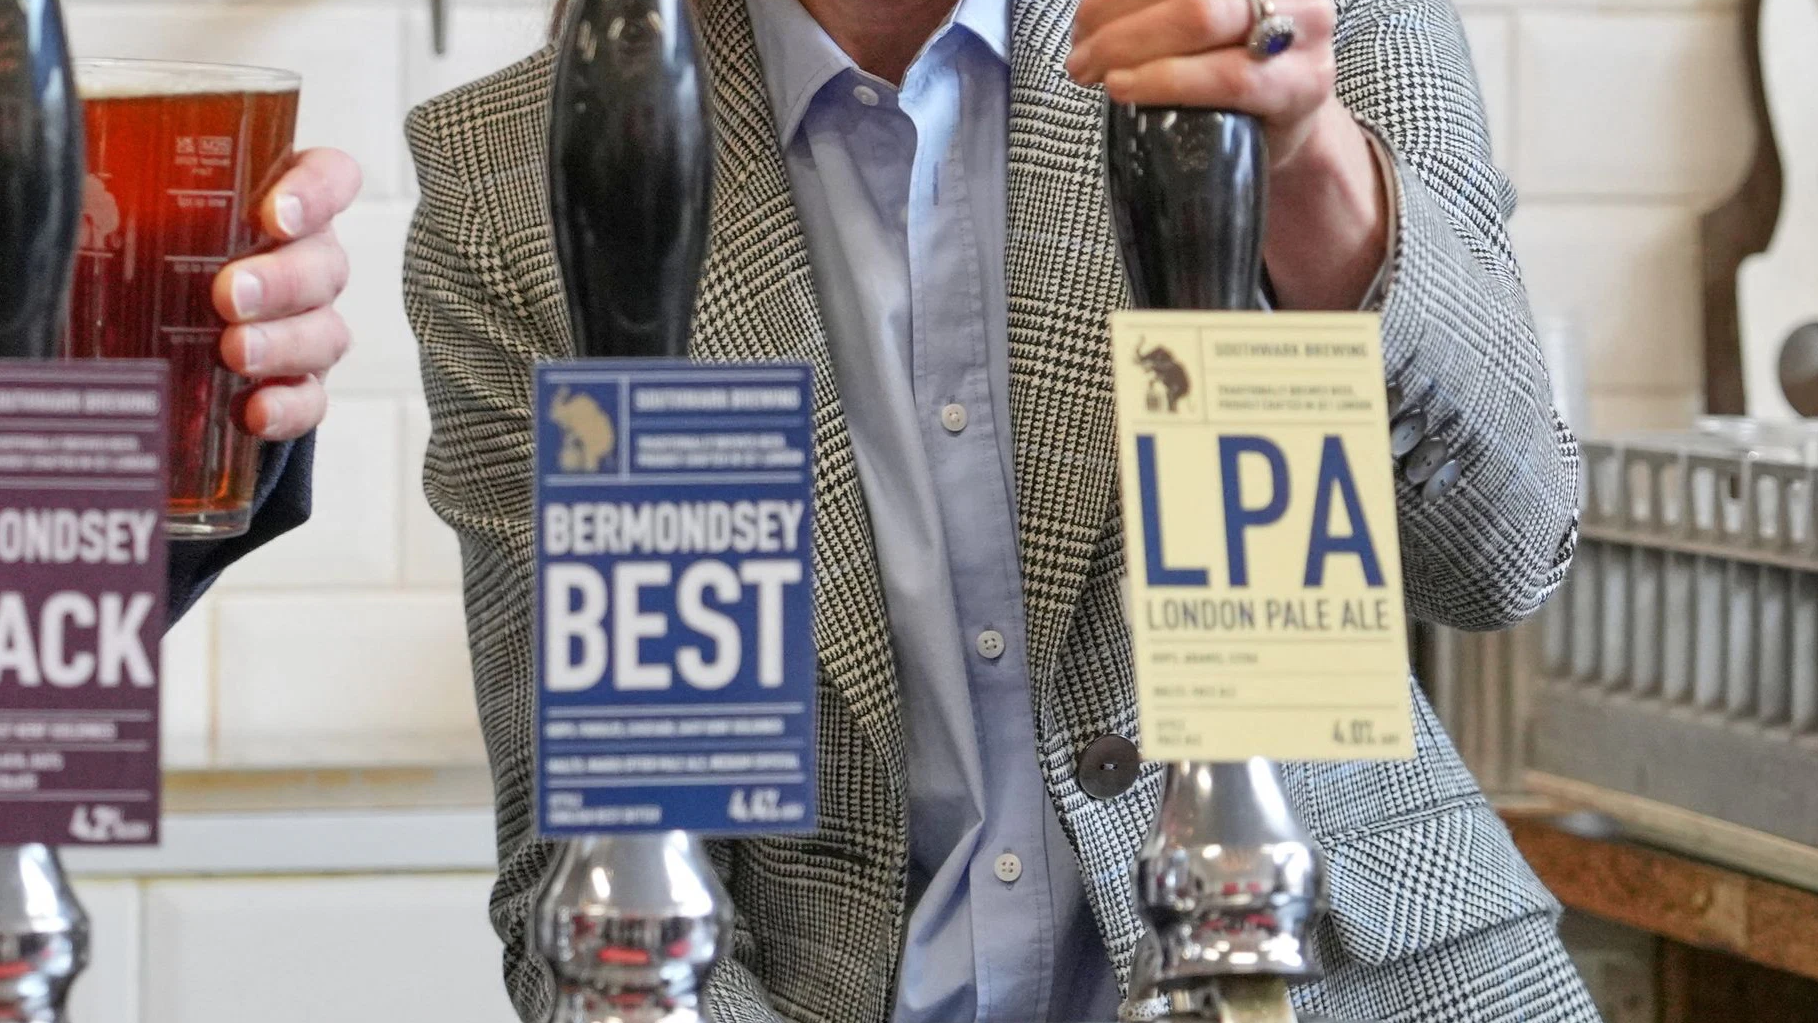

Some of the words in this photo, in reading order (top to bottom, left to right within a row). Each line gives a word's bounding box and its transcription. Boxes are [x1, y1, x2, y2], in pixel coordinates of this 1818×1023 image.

[1215, 342, 1298, 357] SOUTHWARK
[1305, 343, 1368, 358] BREWING
[544, 500, 804, 555] BERMONDSEY
[1136, 434, 1386, 588] LPA
[544, 561, 802, 691] BEST
[1145, 598, 1255, 631] LONDON
[1266, 598, 1330, 631] PALE
[1341, 599, 1390, 631] ALE
[1332, 718, 1377, 746] 4.0%
